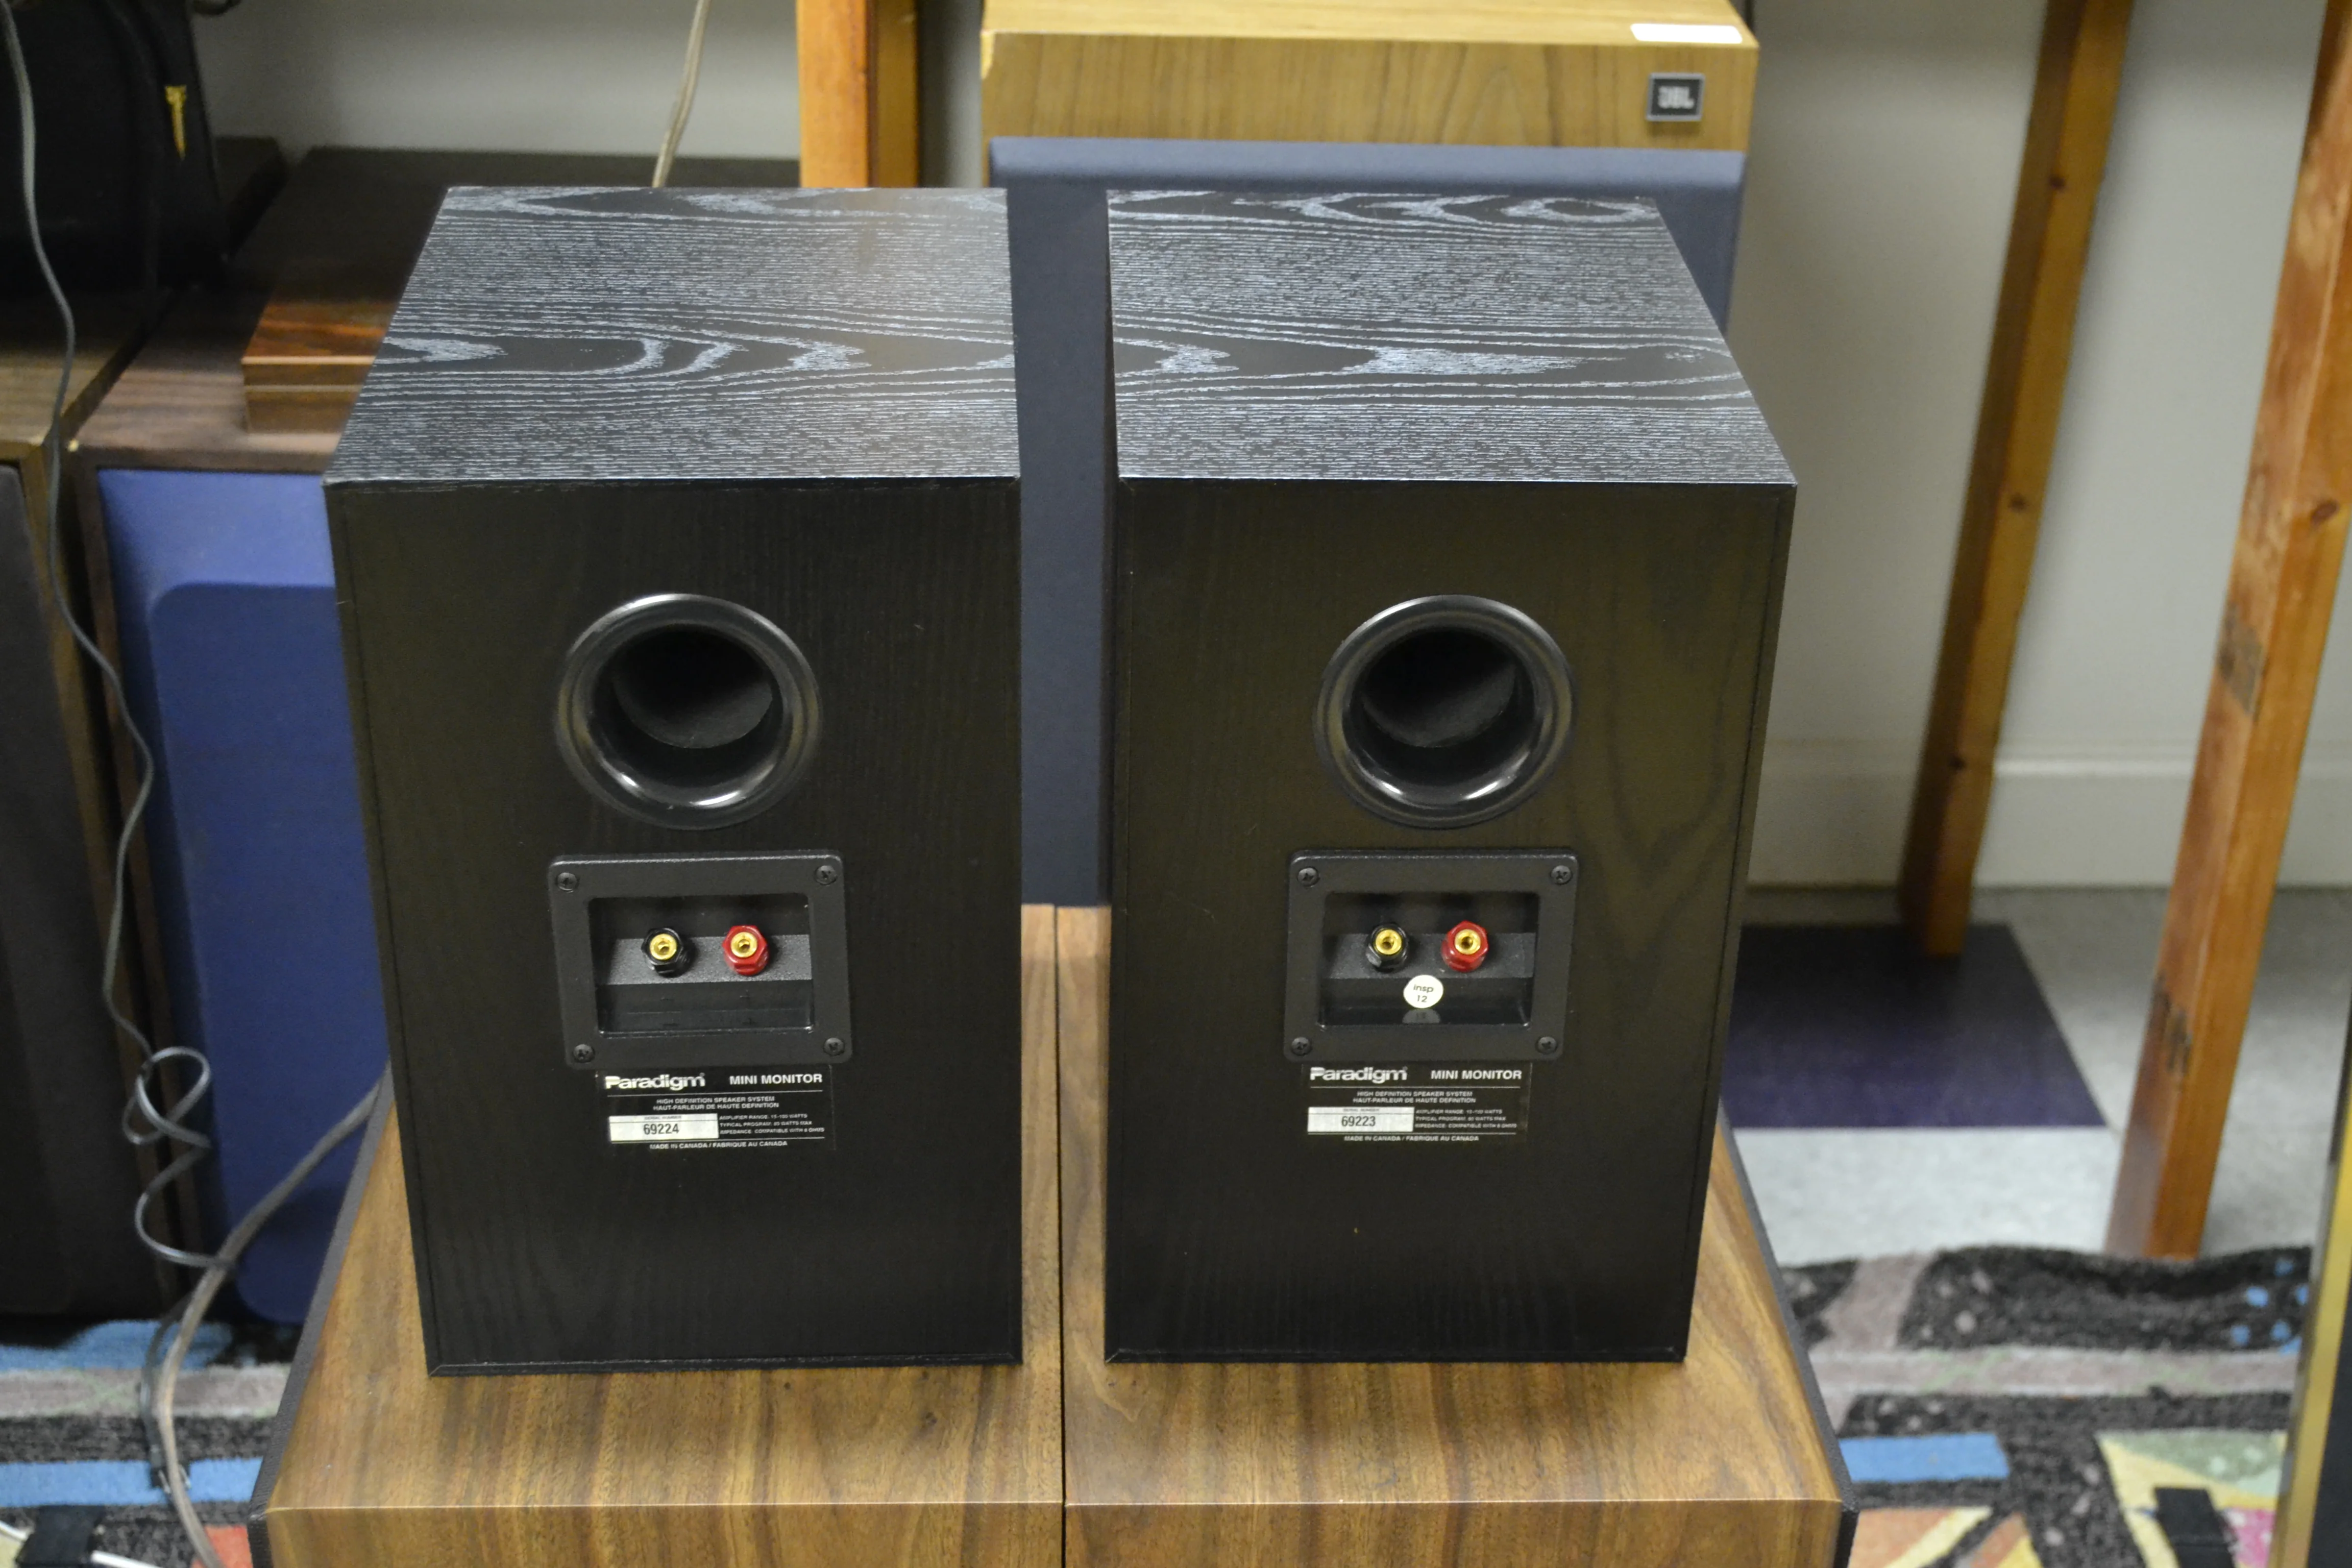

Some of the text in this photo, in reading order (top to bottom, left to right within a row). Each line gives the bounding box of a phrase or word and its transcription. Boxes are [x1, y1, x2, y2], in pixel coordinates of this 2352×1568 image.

[1413, 984, 1434, 993] insp
[729, 1073, 823, 1085] MINI MONITOR
[1310, 1067, 1407, 1084] Paradigm
[1431, 1070, 1522, 1080] MINI MONITOR
[605, 1074, 705, 1091] Paradigm
[1341, 1116, 1376, 1126] 69223
[643, 1123, 679, 1135] 69224
